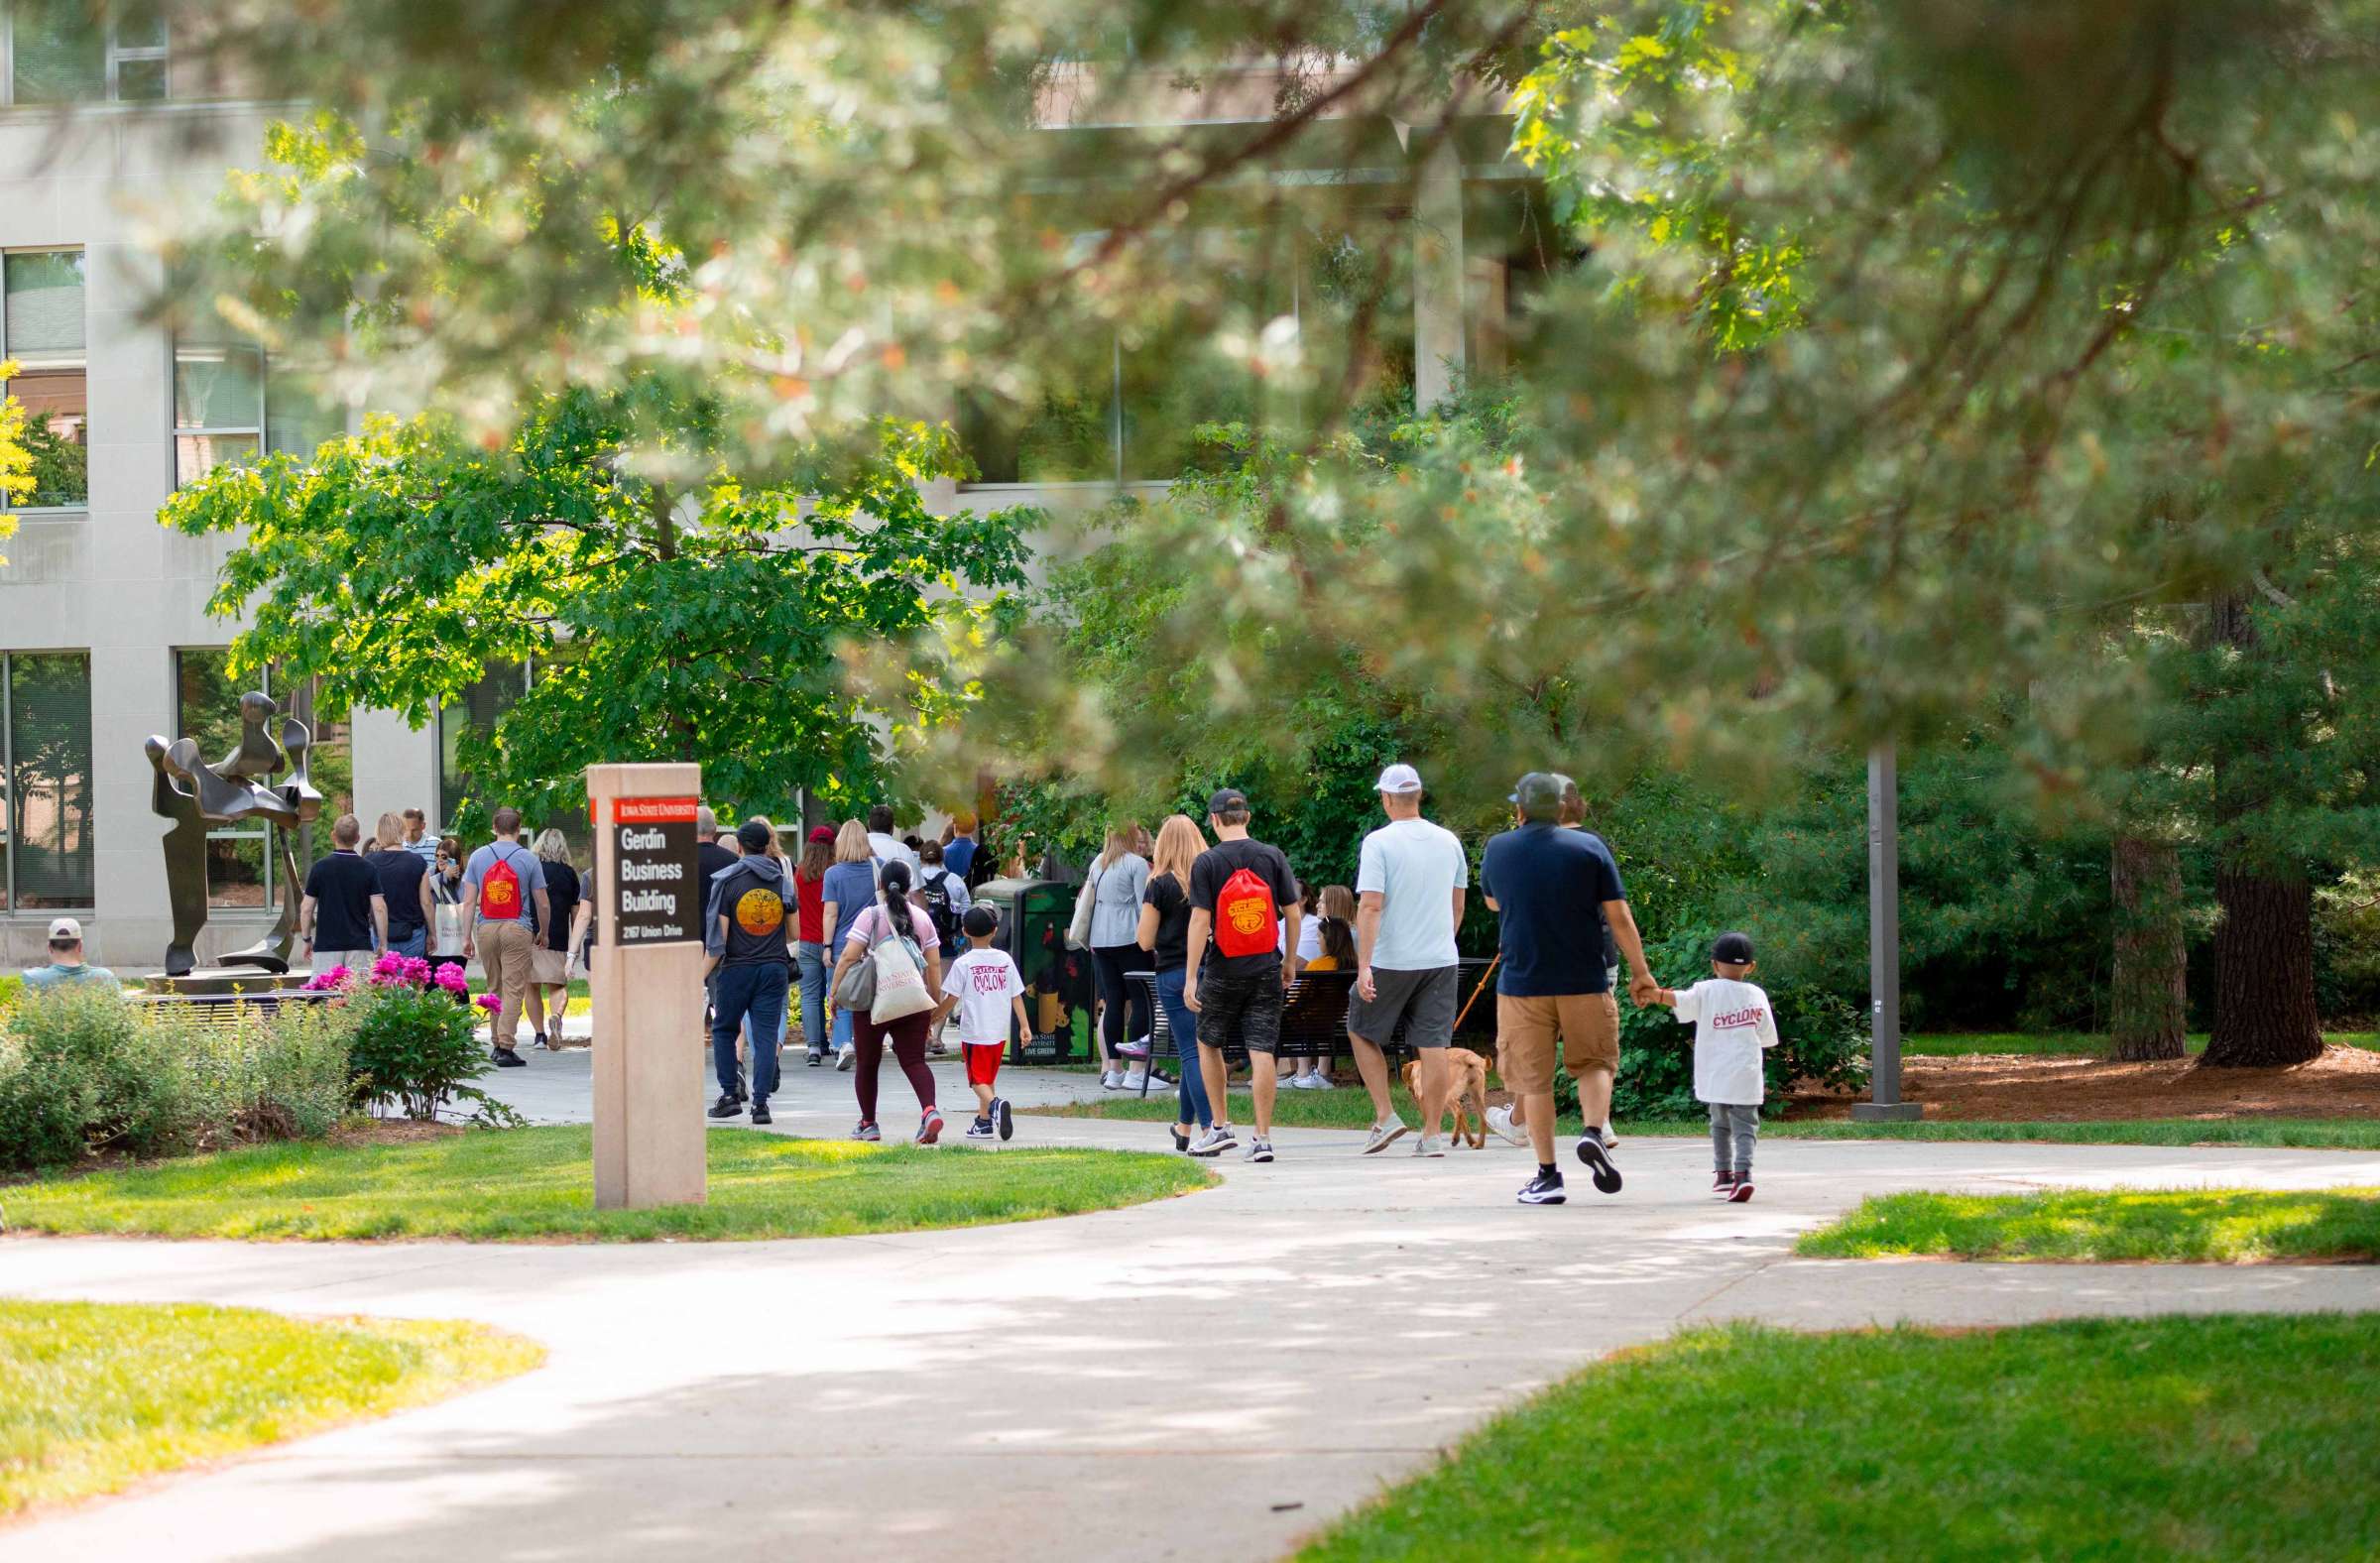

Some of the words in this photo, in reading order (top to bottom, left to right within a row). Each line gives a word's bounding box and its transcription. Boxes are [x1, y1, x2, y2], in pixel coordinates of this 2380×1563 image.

[621, 804, 639, 817] IOWA
[639, 803, 658, 817] STATE
[658, 803, 695, 816] UNIVERSITY
[621, 828, 666, 850] Gerdin
[621, 859, 683, 882] Business
[622, 890, 676, 915] Building
[623, 926, 640, 939] 2167
[641, 926, 662, 938] Union
[663, 924, 683, 937] Drive
